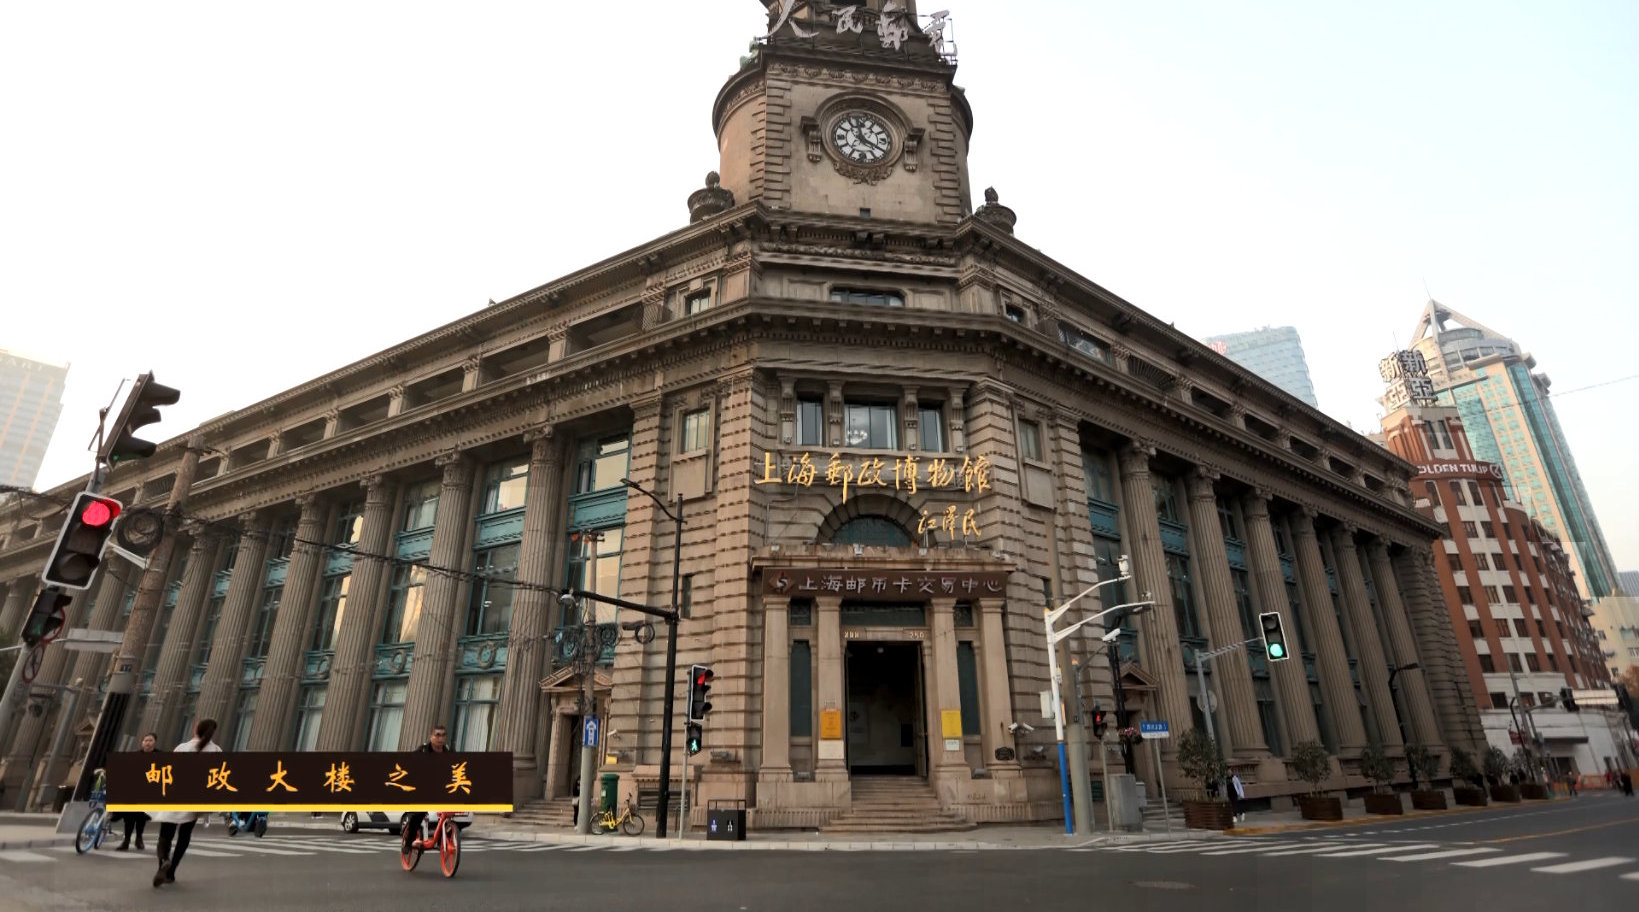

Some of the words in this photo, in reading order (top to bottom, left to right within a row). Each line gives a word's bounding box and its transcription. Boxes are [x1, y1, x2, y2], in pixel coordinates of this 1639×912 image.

[798, 574, 1003, 594] 上海邮币卡交易中心
